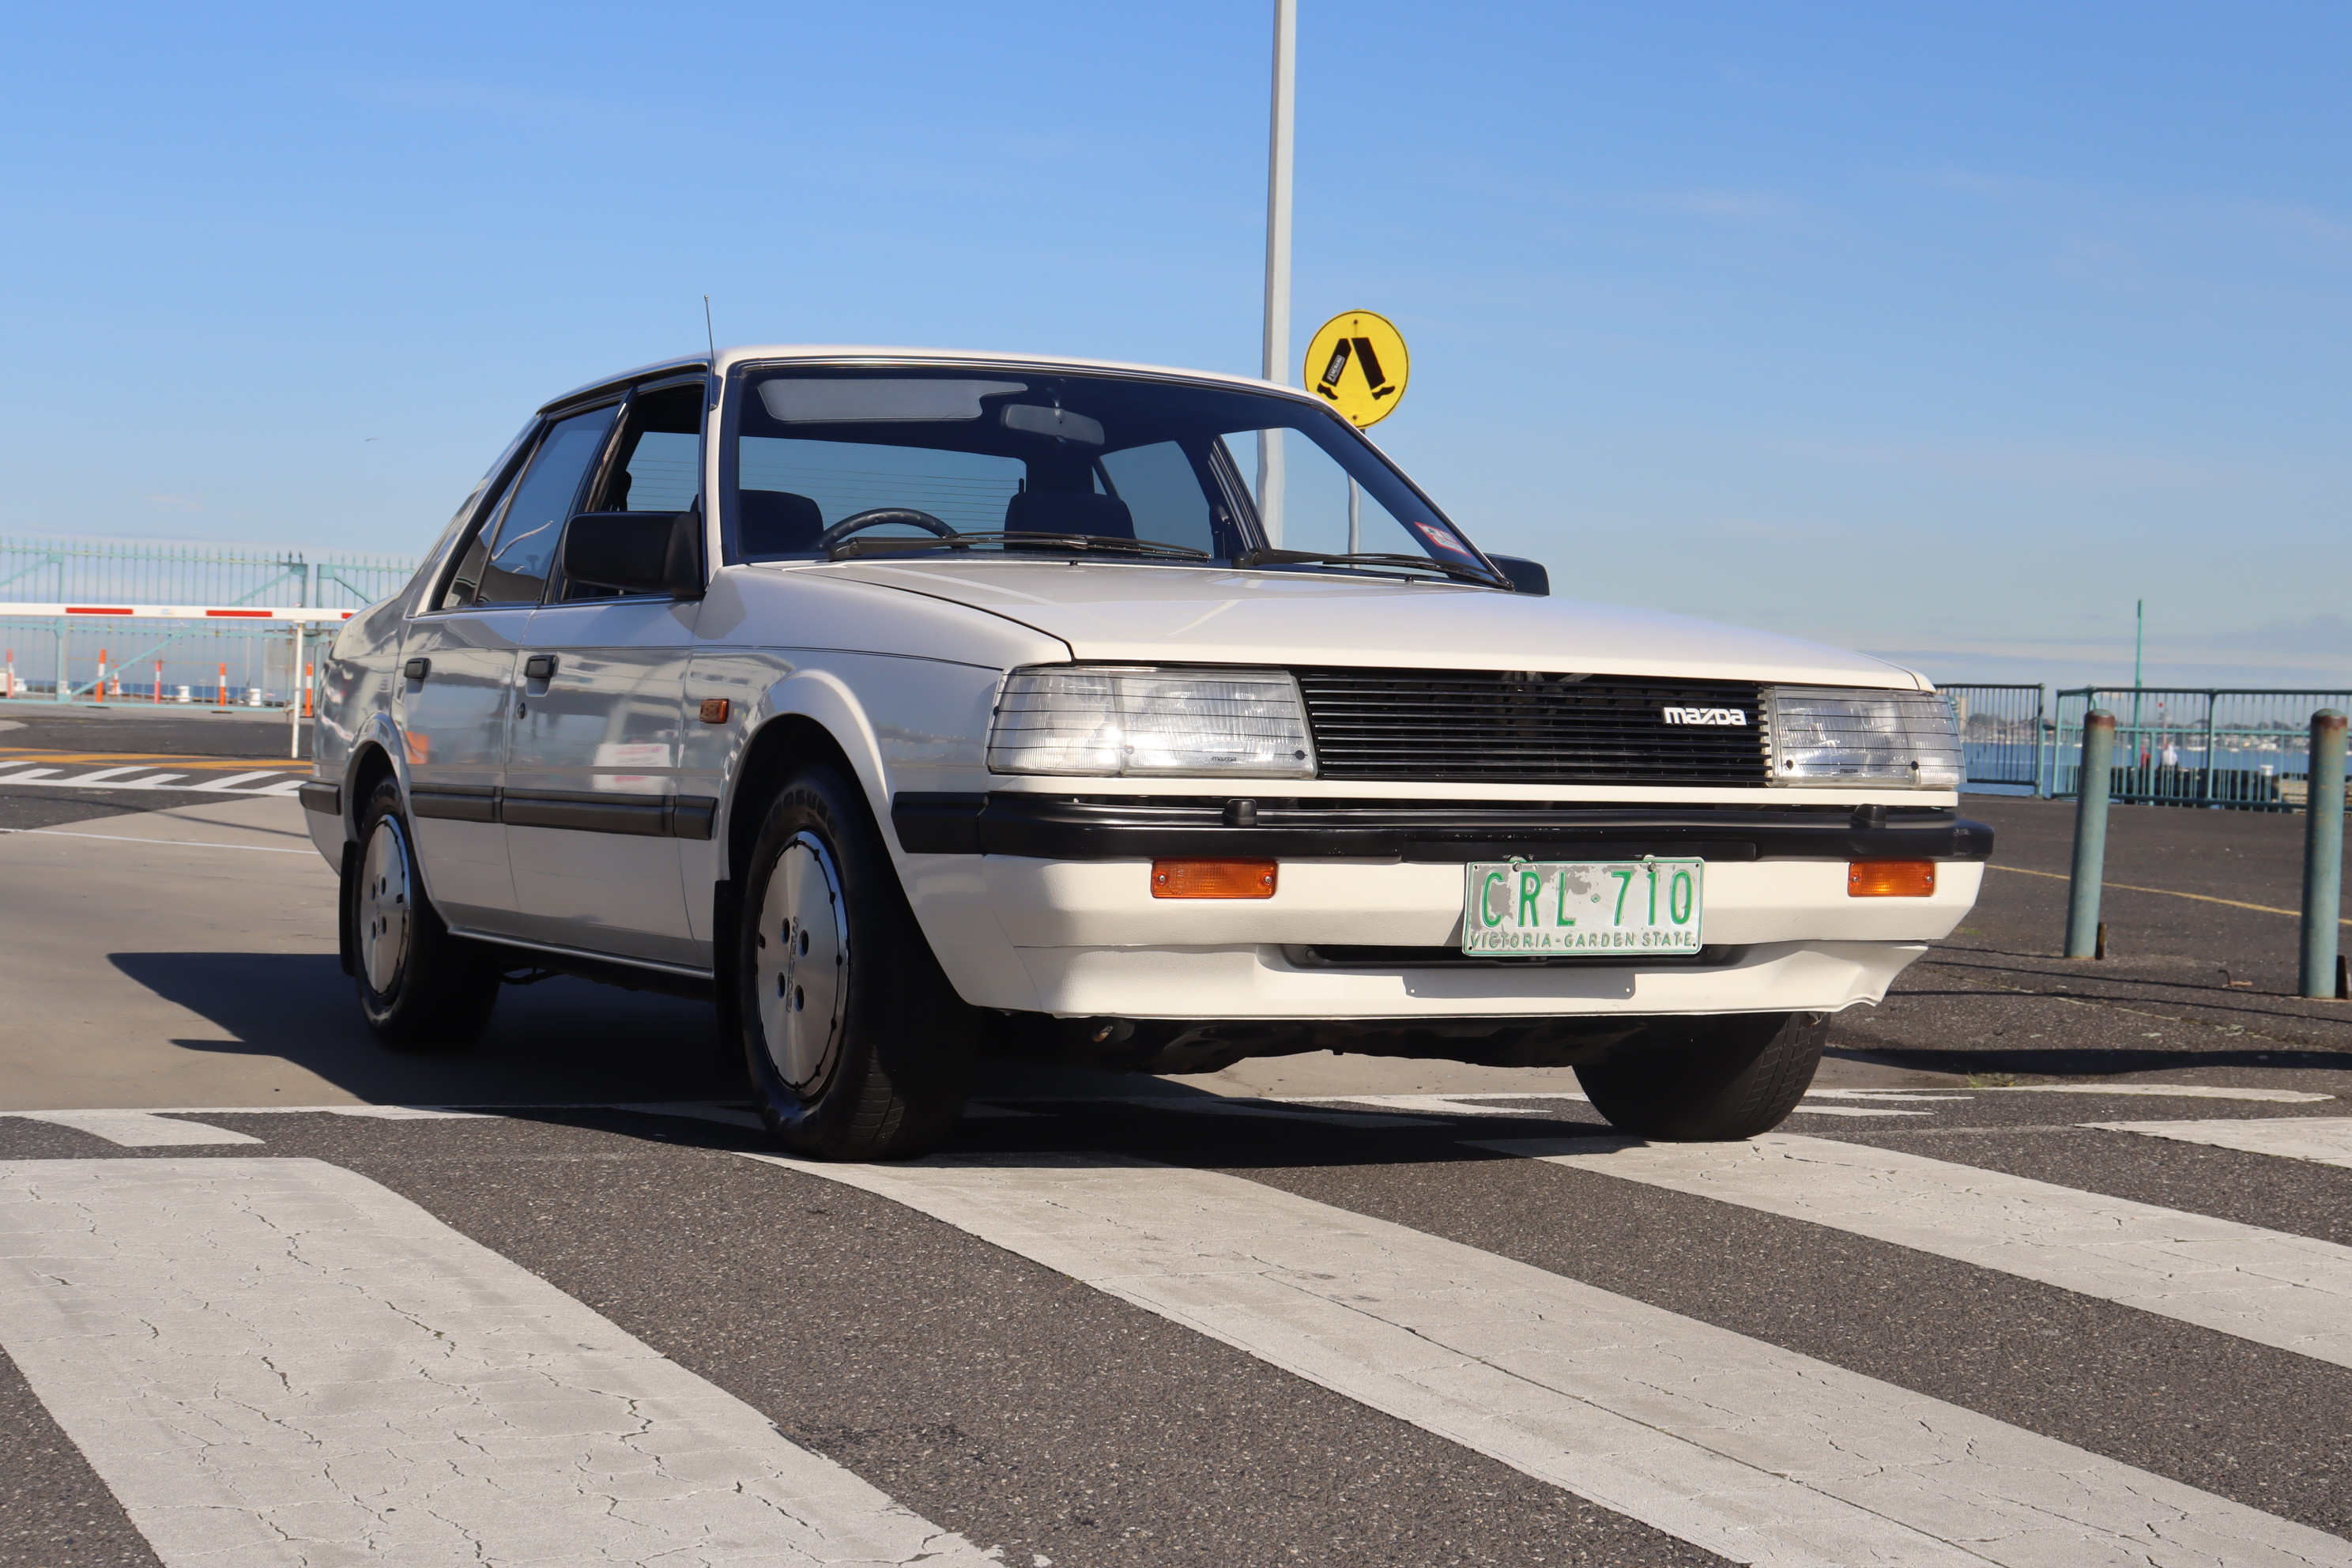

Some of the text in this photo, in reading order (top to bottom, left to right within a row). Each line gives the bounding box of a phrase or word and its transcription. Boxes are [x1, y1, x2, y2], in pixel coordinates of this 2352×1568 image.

[1481, 870, 1692, 927] CRL 710
[1642, 930, 1693, 948] STATE
